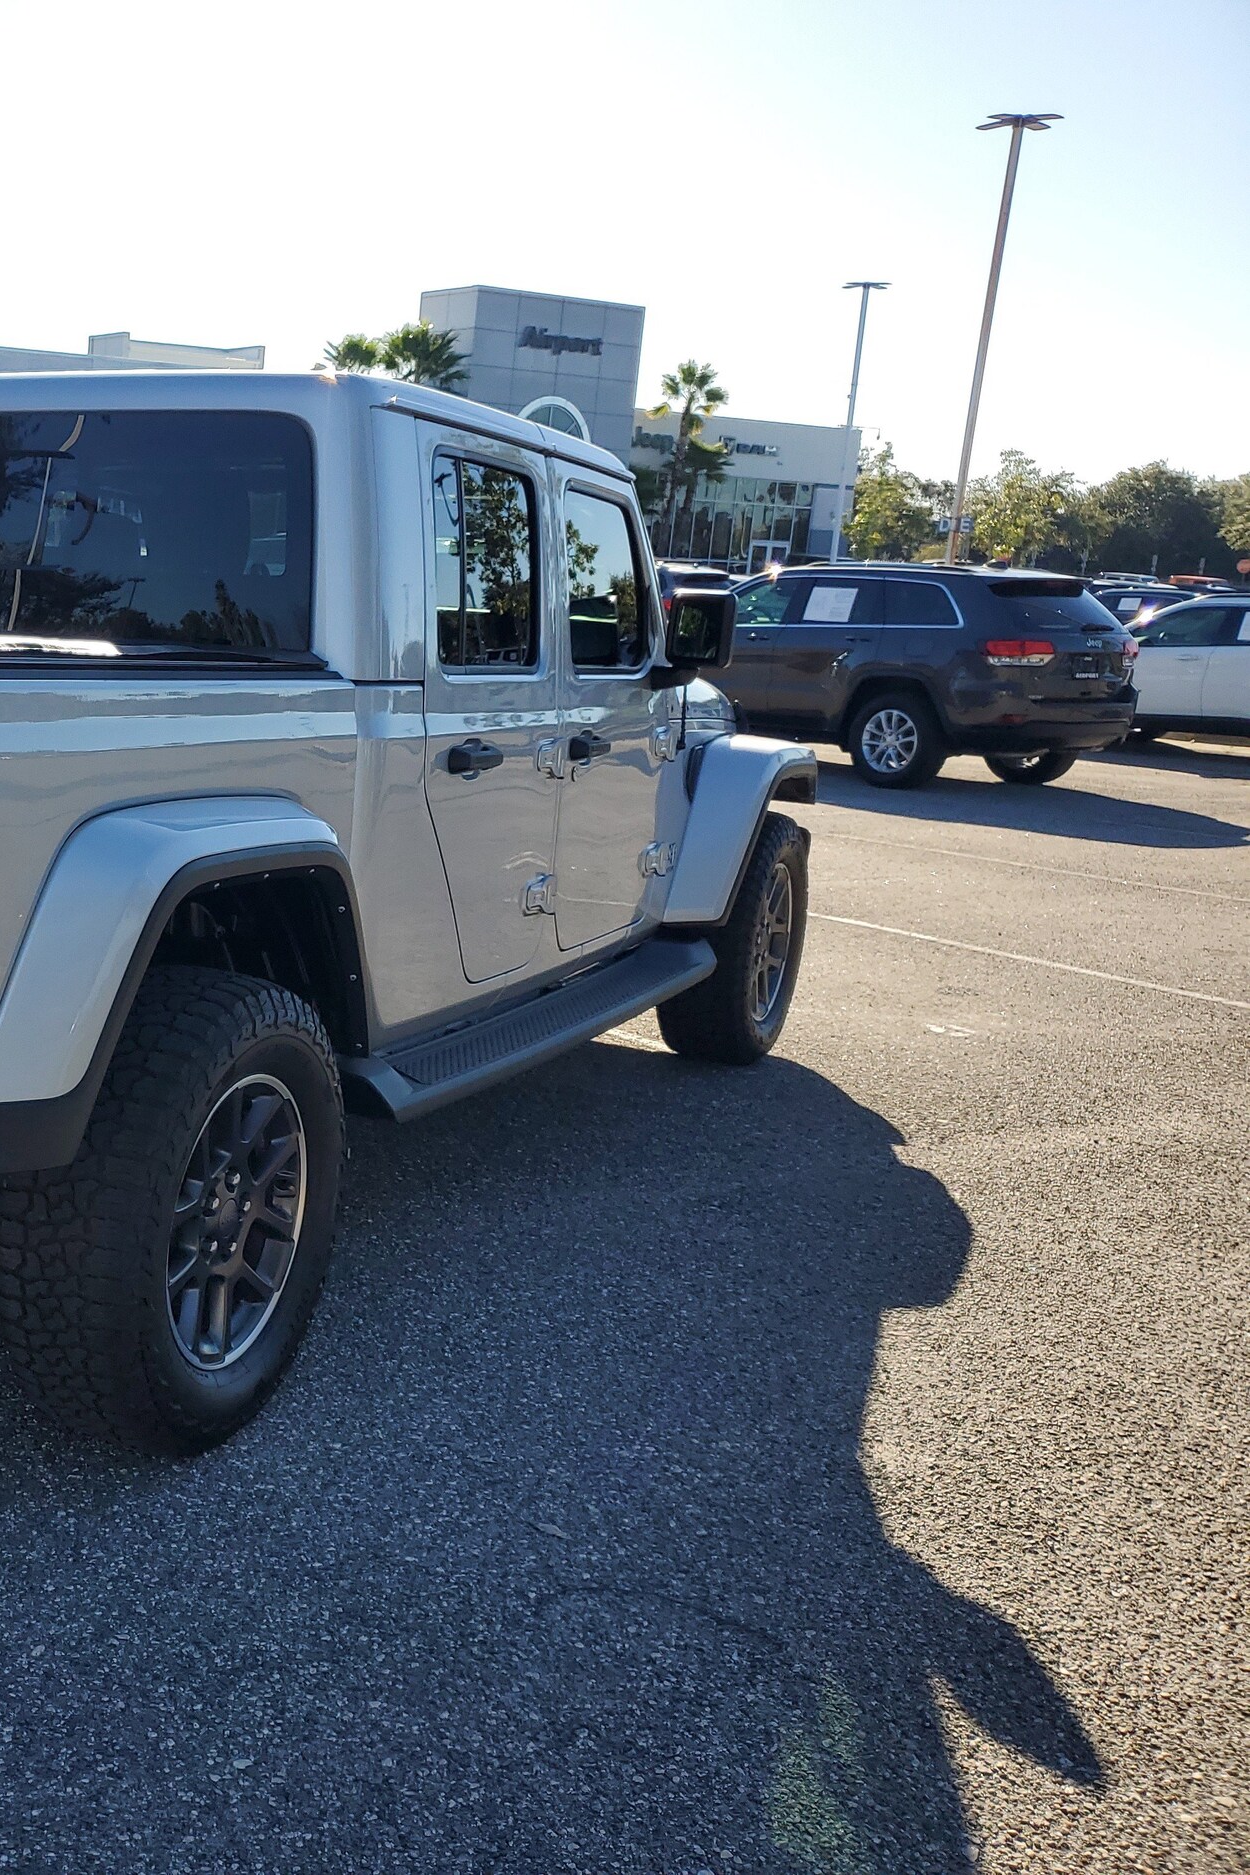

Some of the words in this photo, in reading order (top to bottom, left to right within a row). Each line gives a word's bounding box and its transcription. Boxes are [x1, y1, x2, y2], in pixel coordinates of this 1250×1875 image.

[518, 326, 603, 356] Airport
[631, 426, 674, 454] Jeep
[1086, 638, 1103, 648] Jeep
